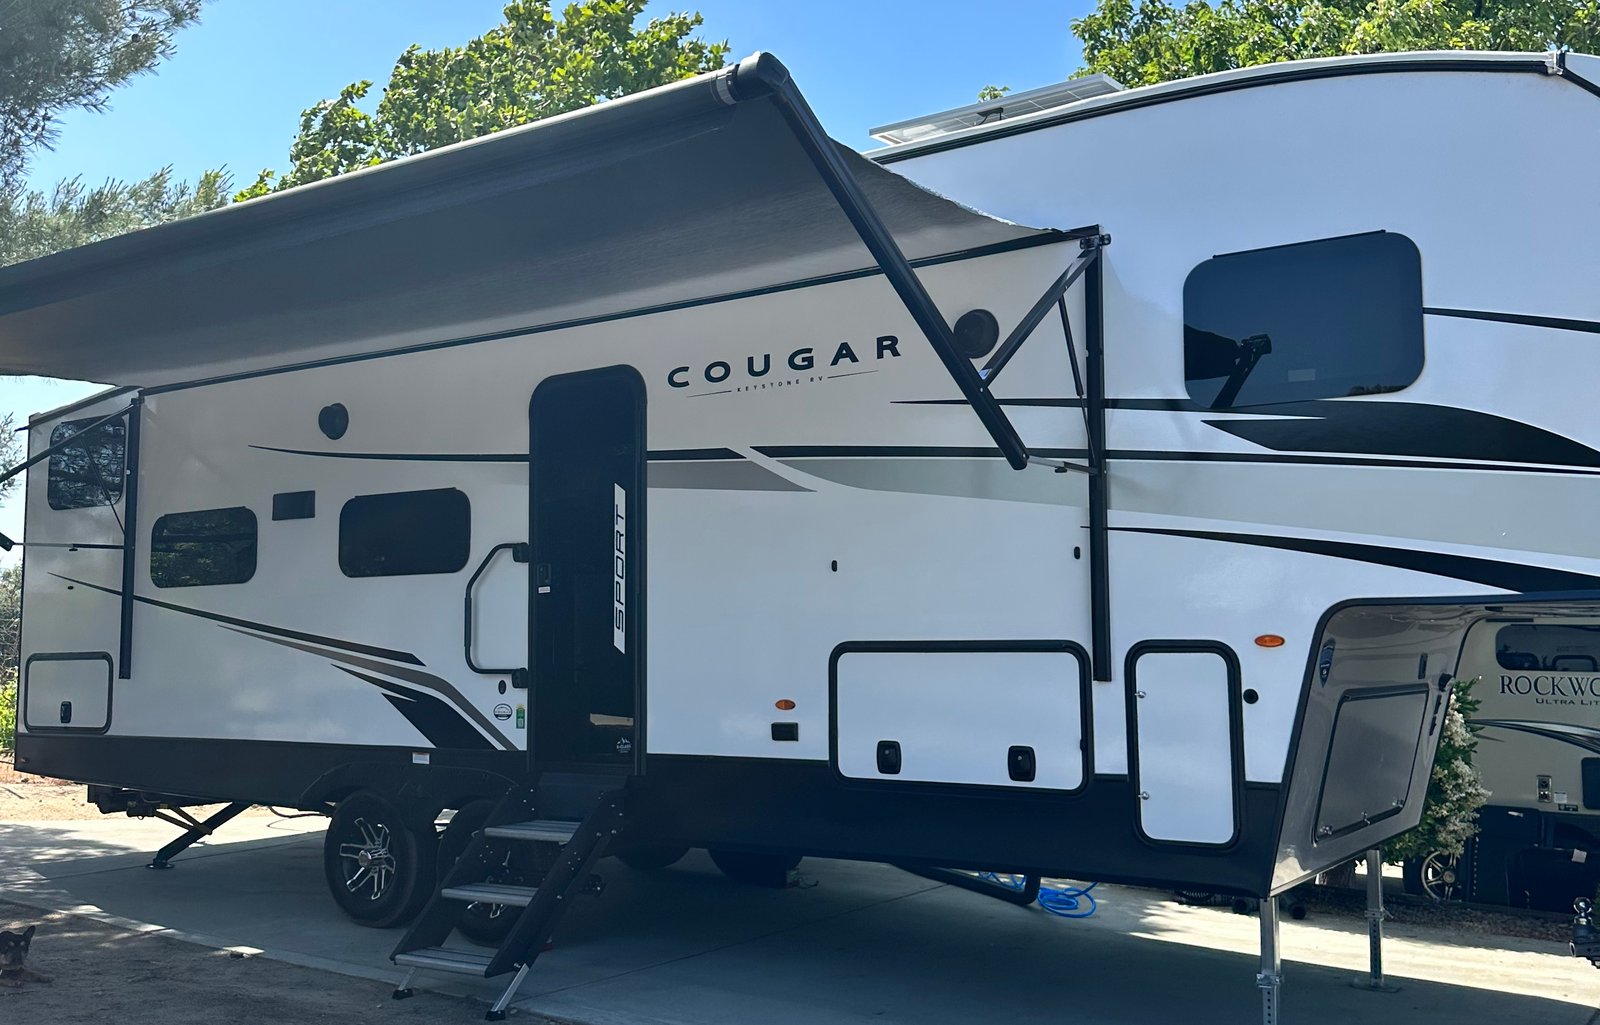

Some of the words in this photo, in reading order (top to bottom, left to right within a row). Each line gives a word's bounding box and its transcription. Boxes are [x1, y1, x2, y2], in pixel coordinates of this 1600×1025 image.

[667, 335, 901, 388] COUGAR
[737, 379, 800, 392] KEYSTONE
[809, 375, 823, 383] RV
[615, 504, 625, 632] SPORT
